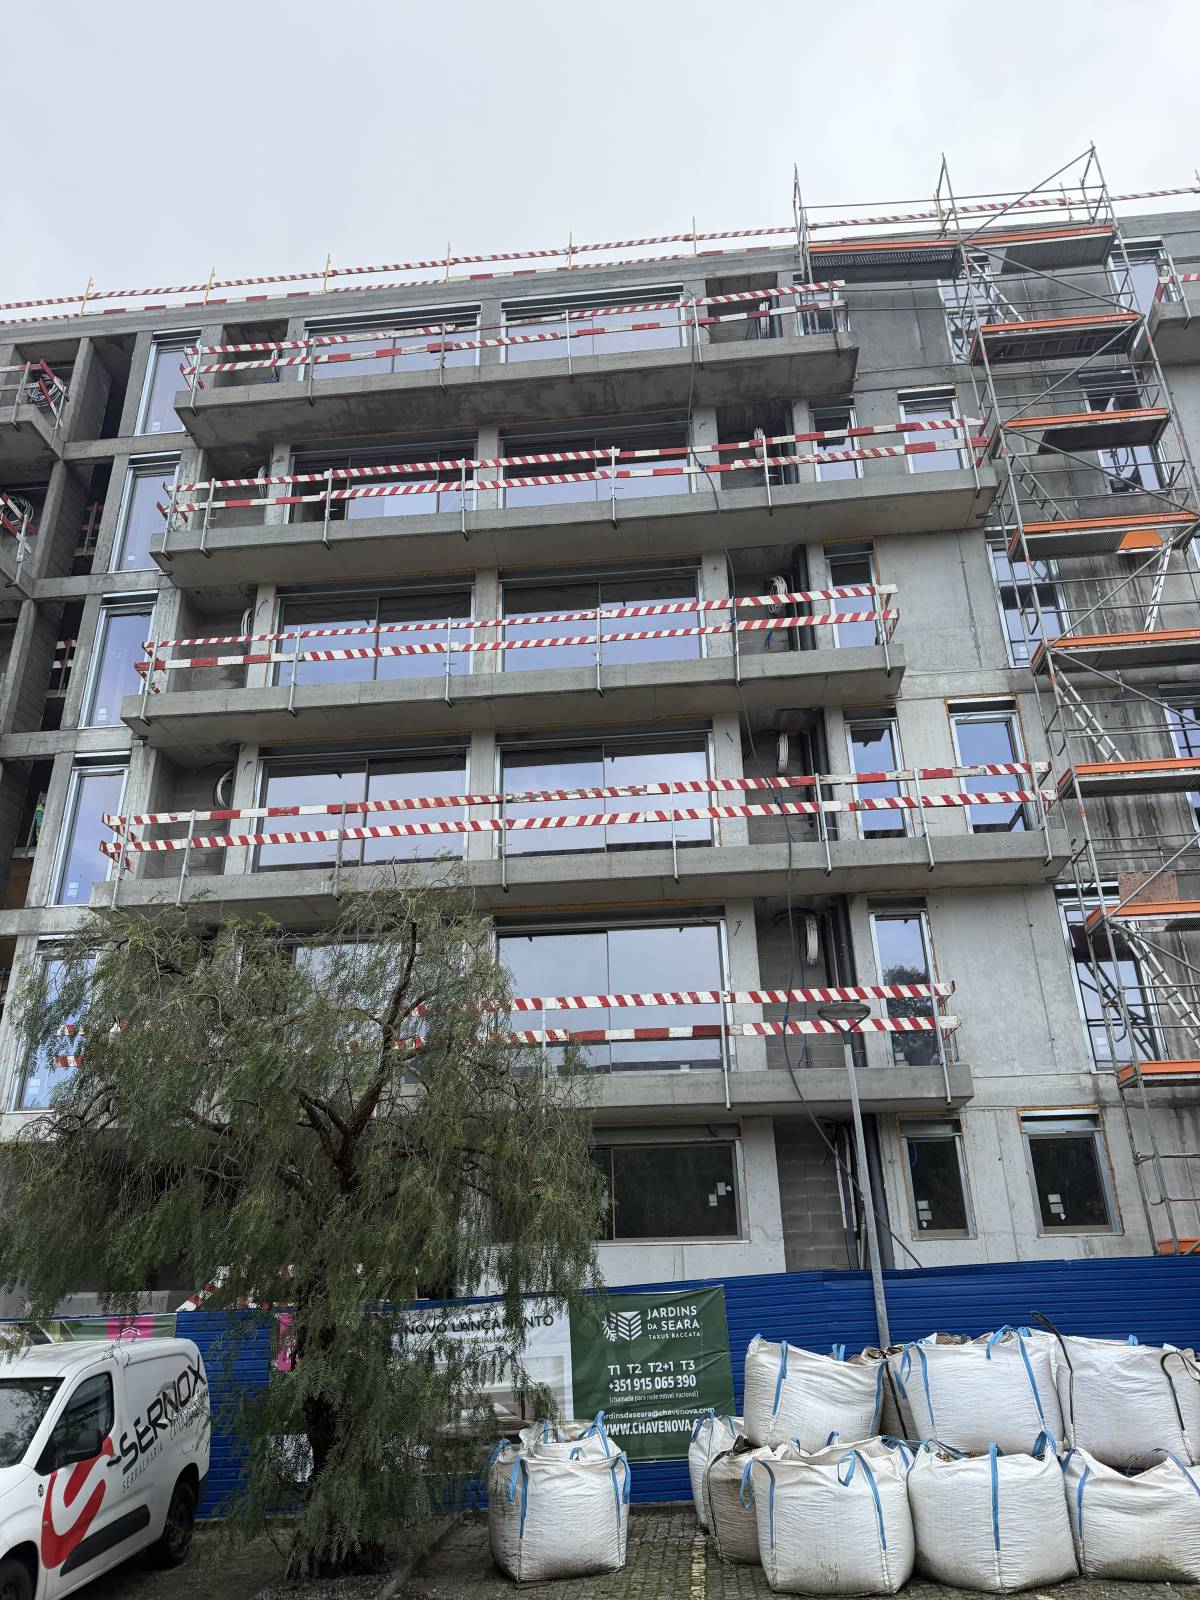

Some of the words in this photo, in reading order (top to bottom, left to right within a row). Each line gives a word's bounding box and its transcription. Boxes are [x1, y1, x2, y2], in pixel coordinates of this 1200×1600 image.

[647, 1305, 697, 1320] JARDINS
[406, 1322, 447, 1335] NOVO
[661, 1319, 700, 1331] SEARA
[671, 1331, 701, 1339] BACCATA
[607, 1365, 620, 1375] T1
[626, 1363, 642, 1374] T2
[647, 1361, 674, 1373] T2+1
[680, 1360, 695, 1371] T3
[608, 1379, 632, 1392] +351
[633, 1377, 652, 1390] 915
[654, 1376, 675, 1389] 065
[676, 1374, 697, 1388] 390
[634, 1394, 646, 1403] para
[646, 1392, 659, 1401] rede
[119, 1355, 207, 1476] SERNOX
